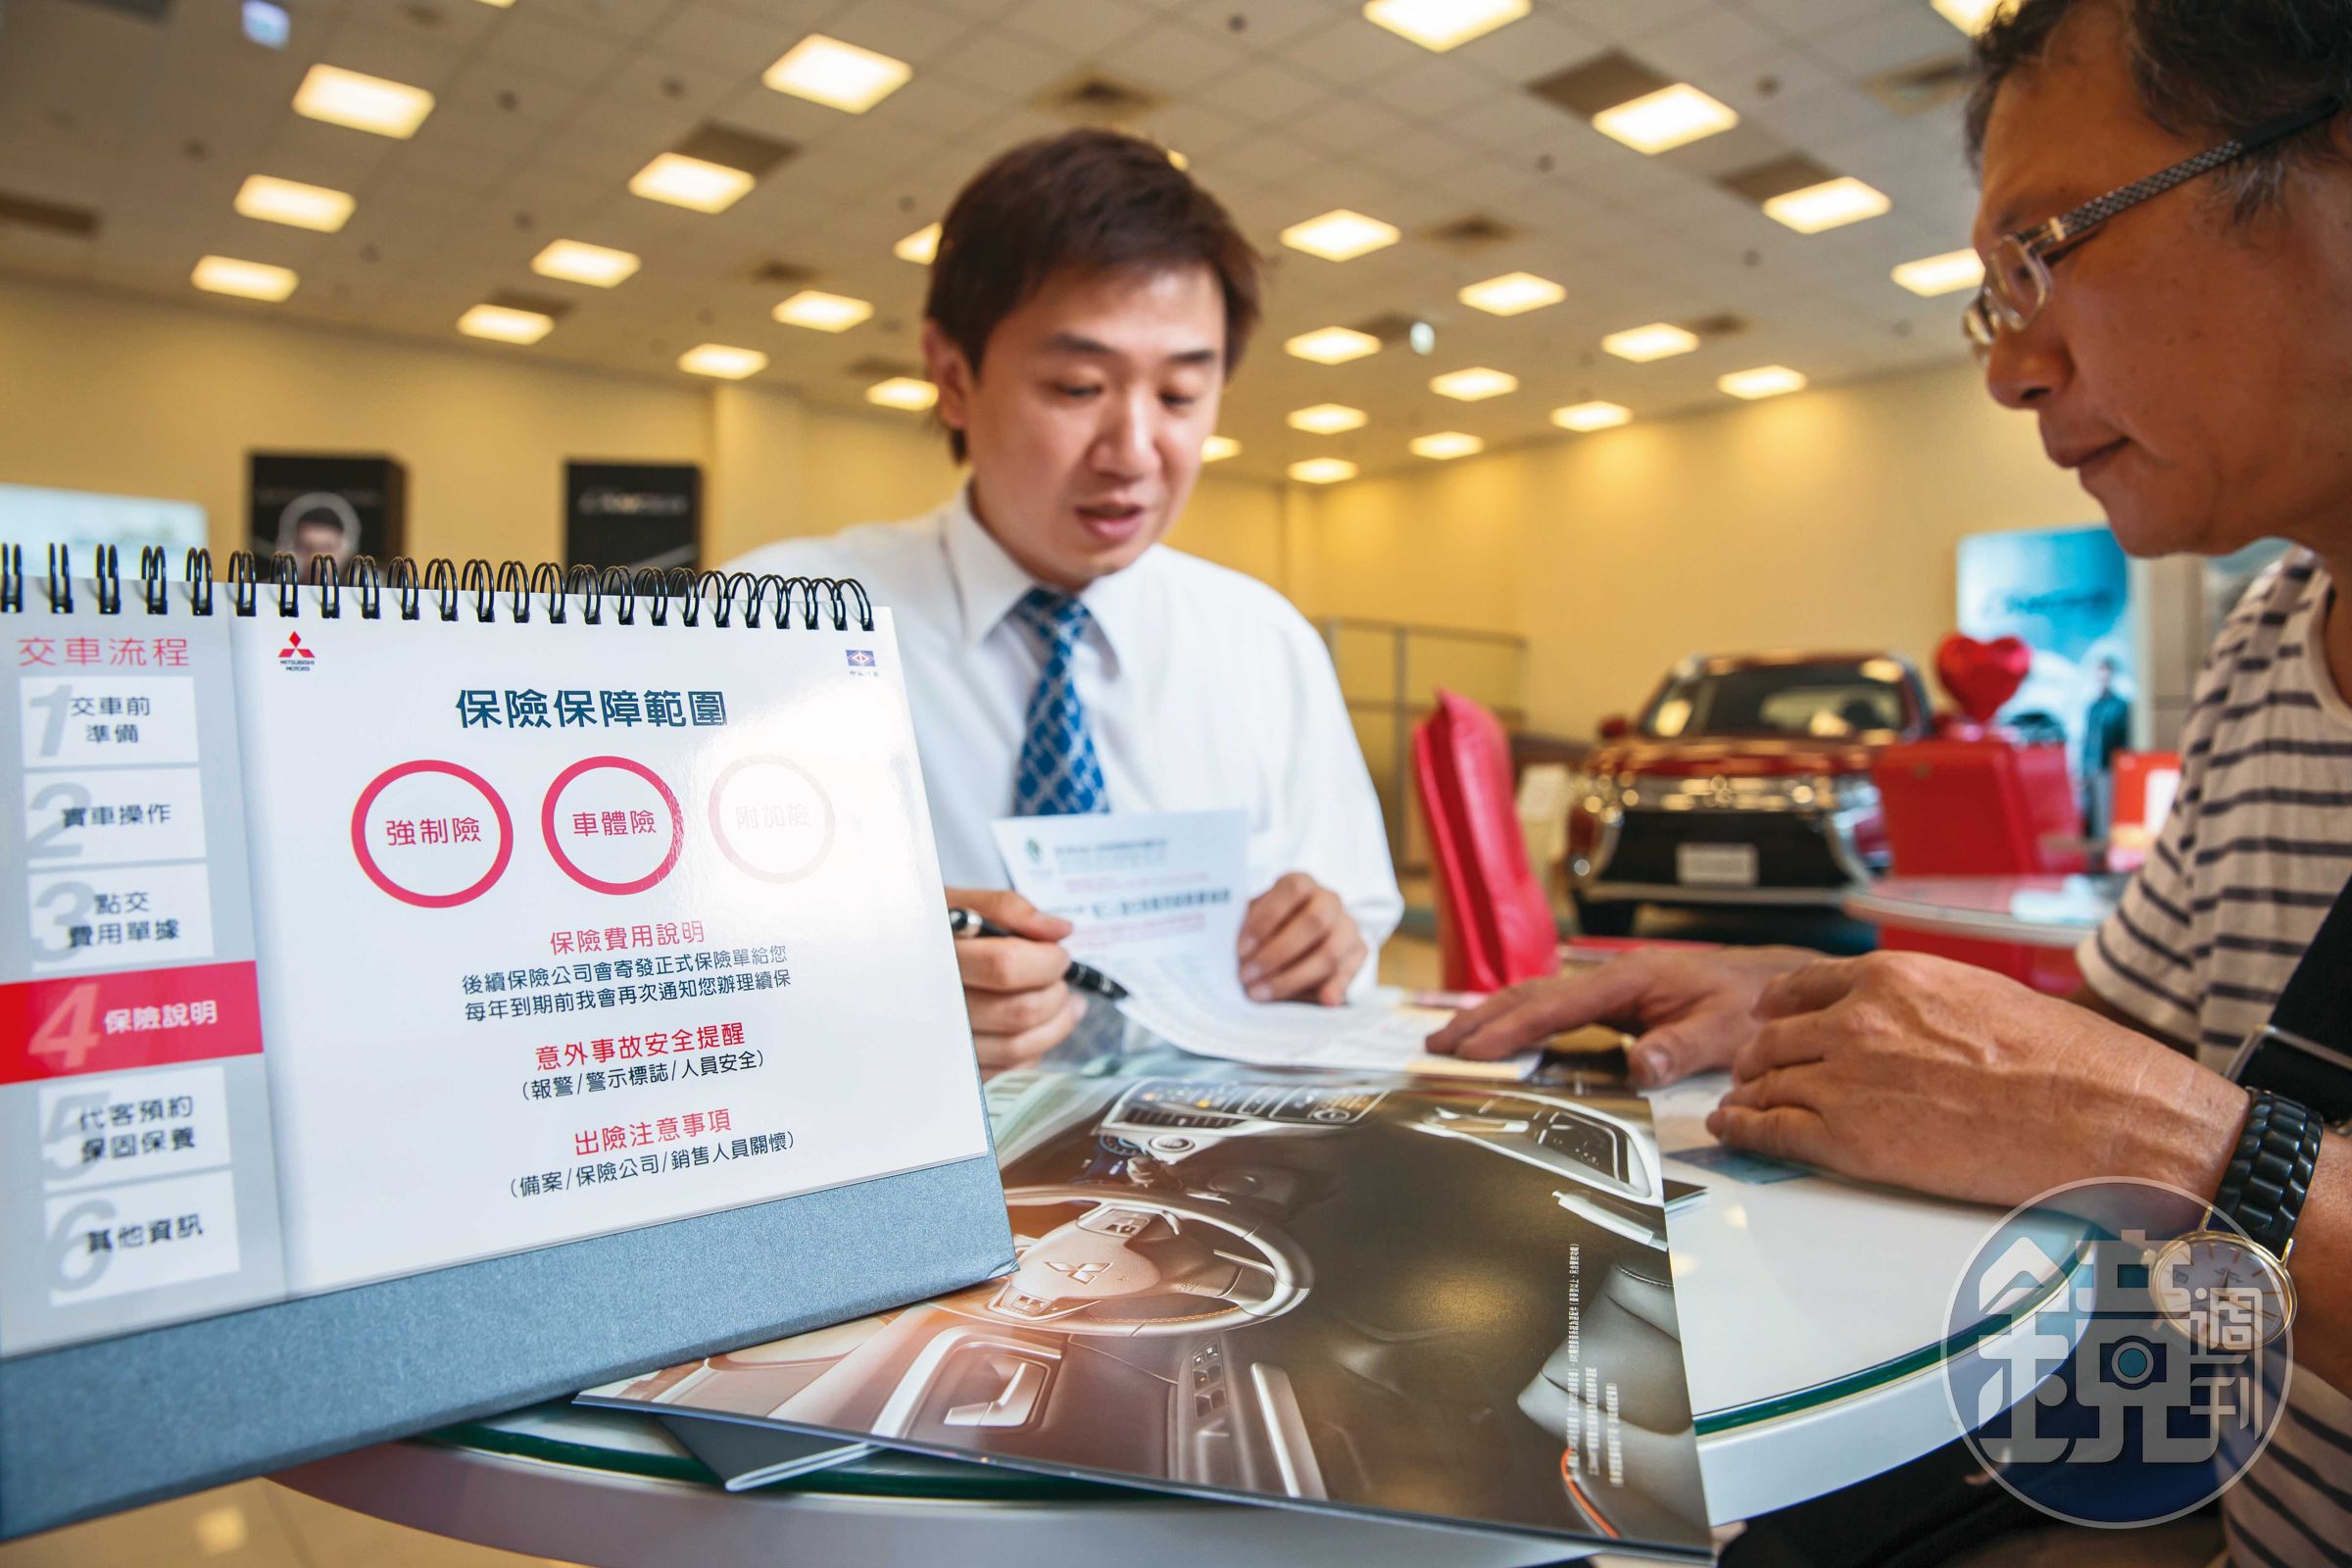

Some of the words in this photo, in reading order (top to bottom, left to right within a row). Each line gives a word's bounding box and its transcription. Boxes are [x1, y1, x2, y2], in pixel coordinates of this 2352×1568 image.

[18, 637, 190, 666] 交車流程
[28, 684, 74, 758] 1
[71, 697, 151, 717] 交車前
[456, 689, 727, 728] 保險保障範圍
[86, 724, 139, 744] 準備
[25, 782, 92, 858] 2
[63, 804, 172, 828] 實車操作
[385, 815, 482, 847] 強制險
[572, 808, 658, 836] 車體險
[735, 804, 810, 830] 附加險
[93, 892, 149, 914] 點交
[32, 881, 96, 962] 3
[69, 918, 180, 949] 費用單據
[550, 920, 705, 956] 保險費用說明
[462, 944, 788, 995] 後續保險公司會寄發正式保險單給您
[465, 968, 791, 1022] 每年到期前我會再次通知您辦理續保
[27, 983, 101, 1069] 4
[104, 1000, 218, 1036] 保險說明
[535, 1022, 746, 1071] 意外事故安全提醒
[79, 1095, 192, 1131] 代客預約
[42, 1091, 112, 1181] 5
[81, 1127, 196, 1163] 保固保養
[574, 1108, 731, 1156] 出險注意事項
[51, 1198, 117, 1295] 6
[84, 1213, 205, 1254] 其他資訊
